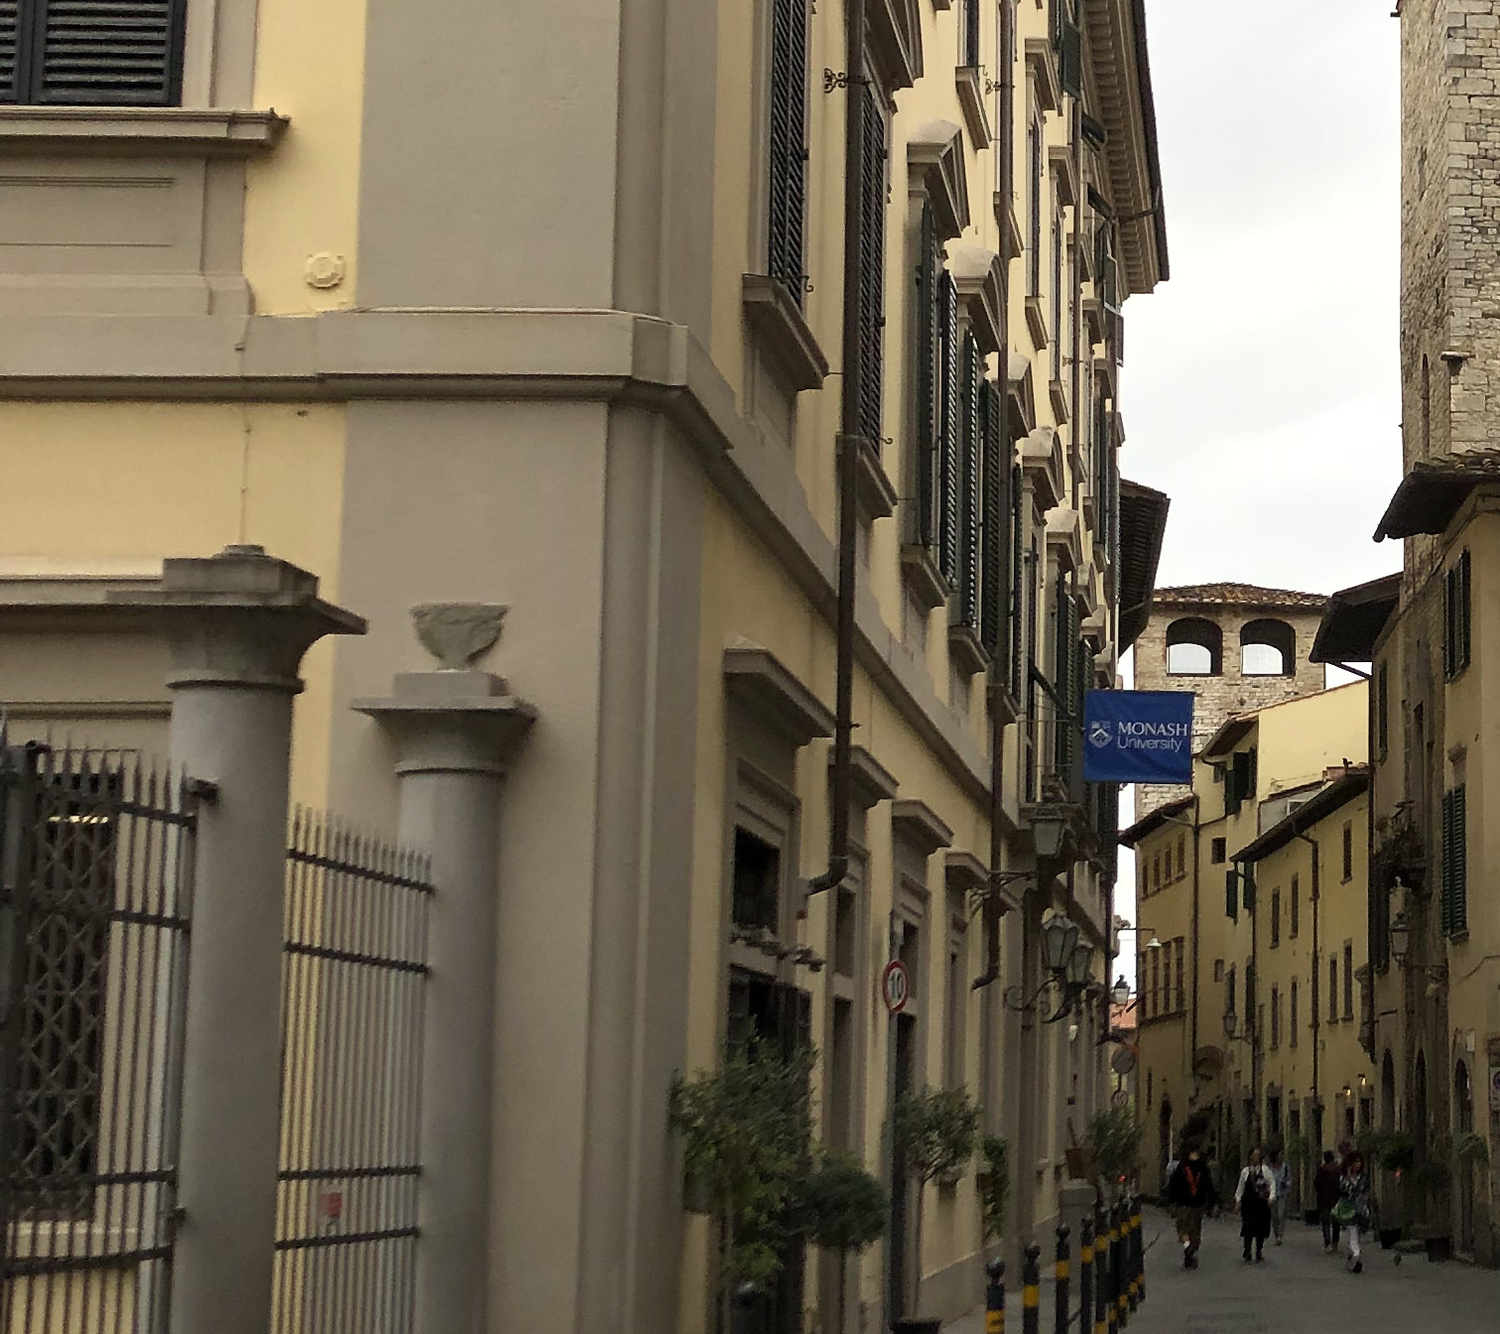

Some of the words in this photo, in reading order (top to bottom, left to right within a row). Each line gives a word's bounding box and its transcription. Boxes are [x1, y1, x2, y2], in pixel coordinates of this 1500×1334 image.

[1118, 721, 1188, 737] MONASH
[1117, 735, 1183, 753] University
[889, 971, 904, 999] 10
